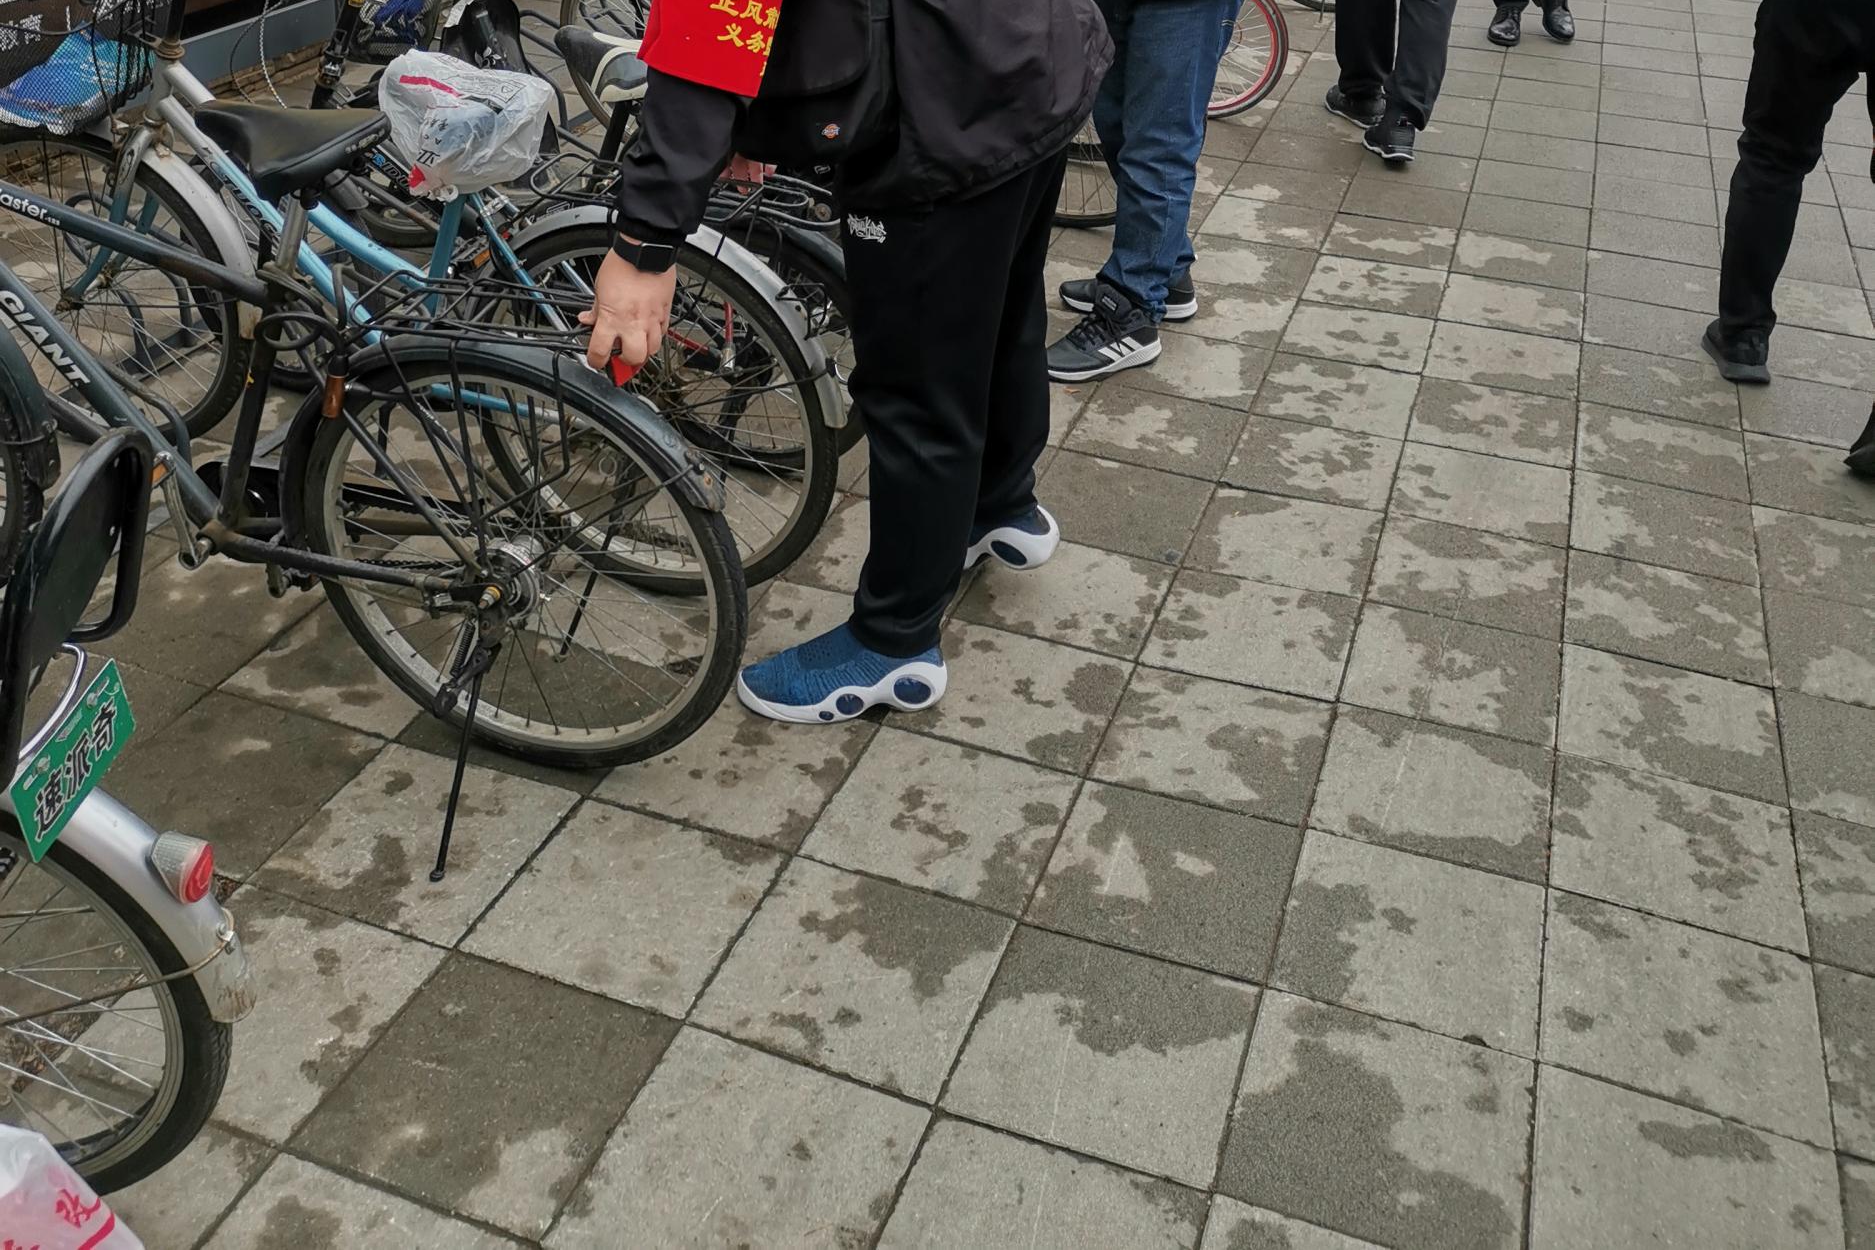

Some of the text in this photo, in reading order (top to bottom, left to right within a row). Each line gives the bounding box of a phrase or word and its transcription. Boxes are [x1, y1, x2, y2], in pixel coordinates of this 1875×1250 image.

[0, 188, 48, 221] aster
[0, 290, 91, 386] GIANT
[34, 697, 118, 843] 速派奇
